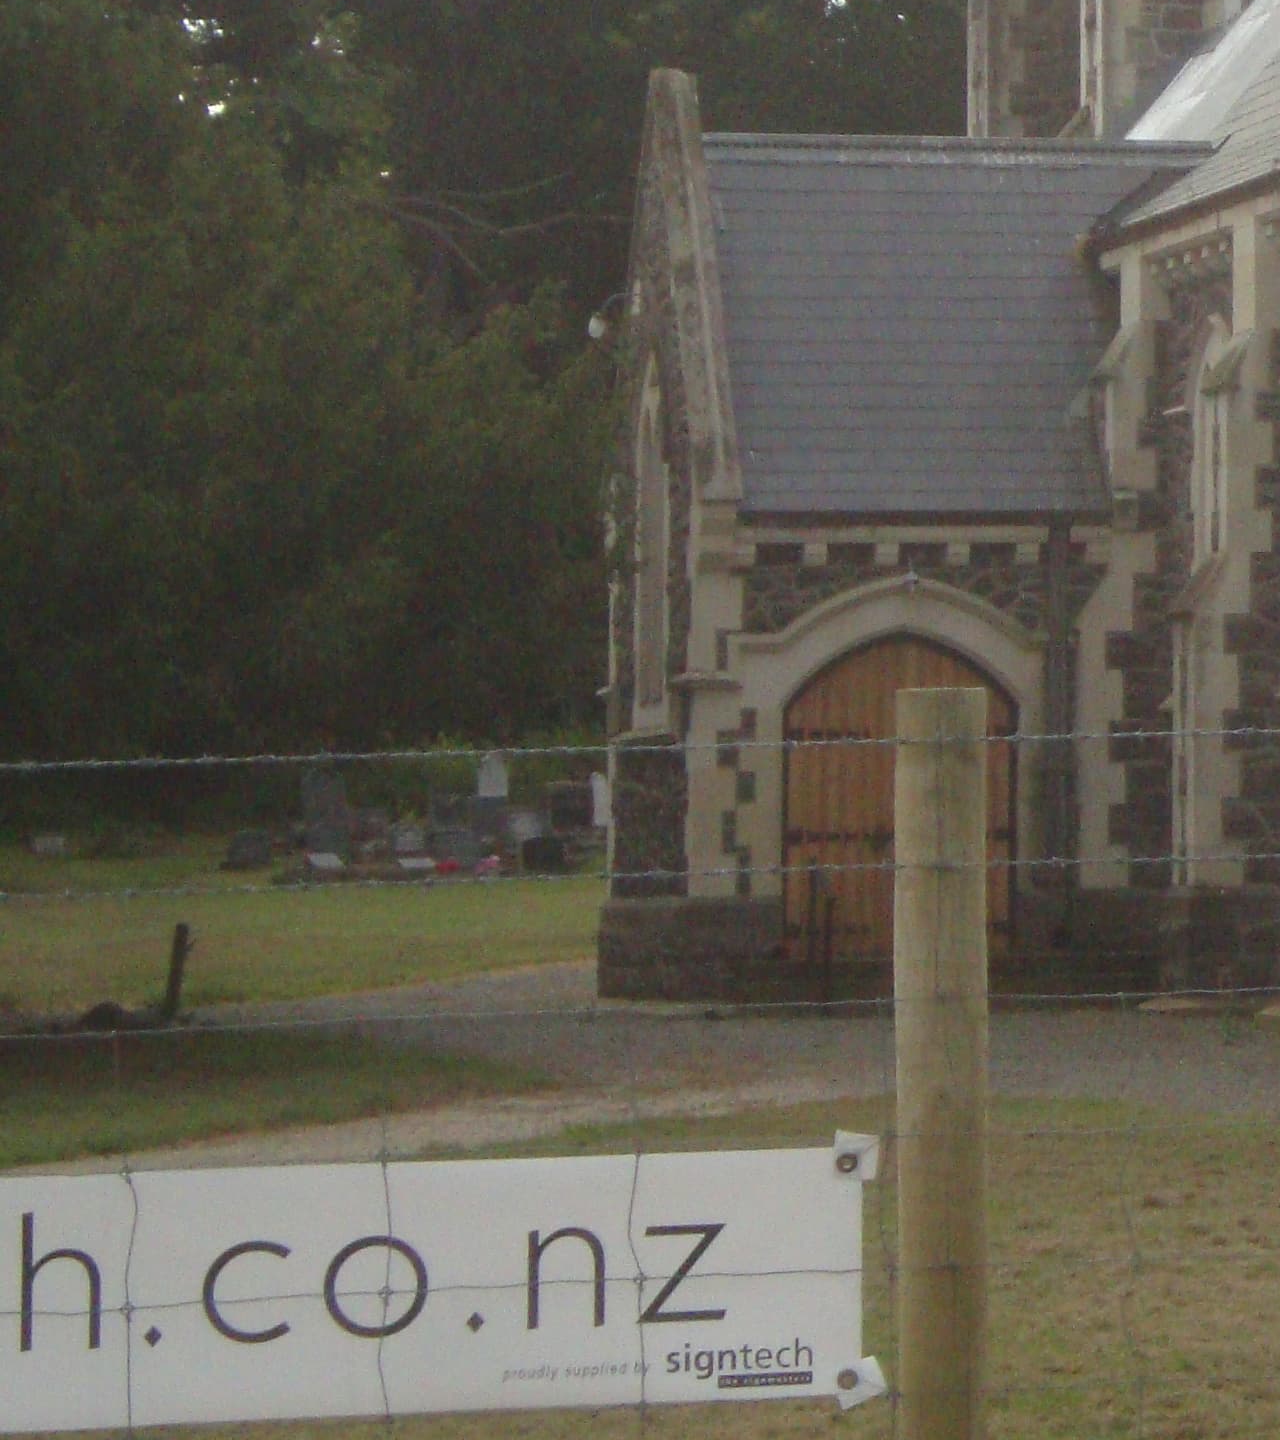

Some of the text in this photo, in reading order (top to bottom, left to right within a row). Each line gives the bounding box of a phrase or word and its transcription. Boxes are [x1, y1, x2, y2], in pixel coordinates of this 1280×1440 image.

[20, 1212, 727, 1351] h.co.nz
[502, 1361, 650, 1383] proudly supplied by
[666, 1337, 813, 1379] signtech
